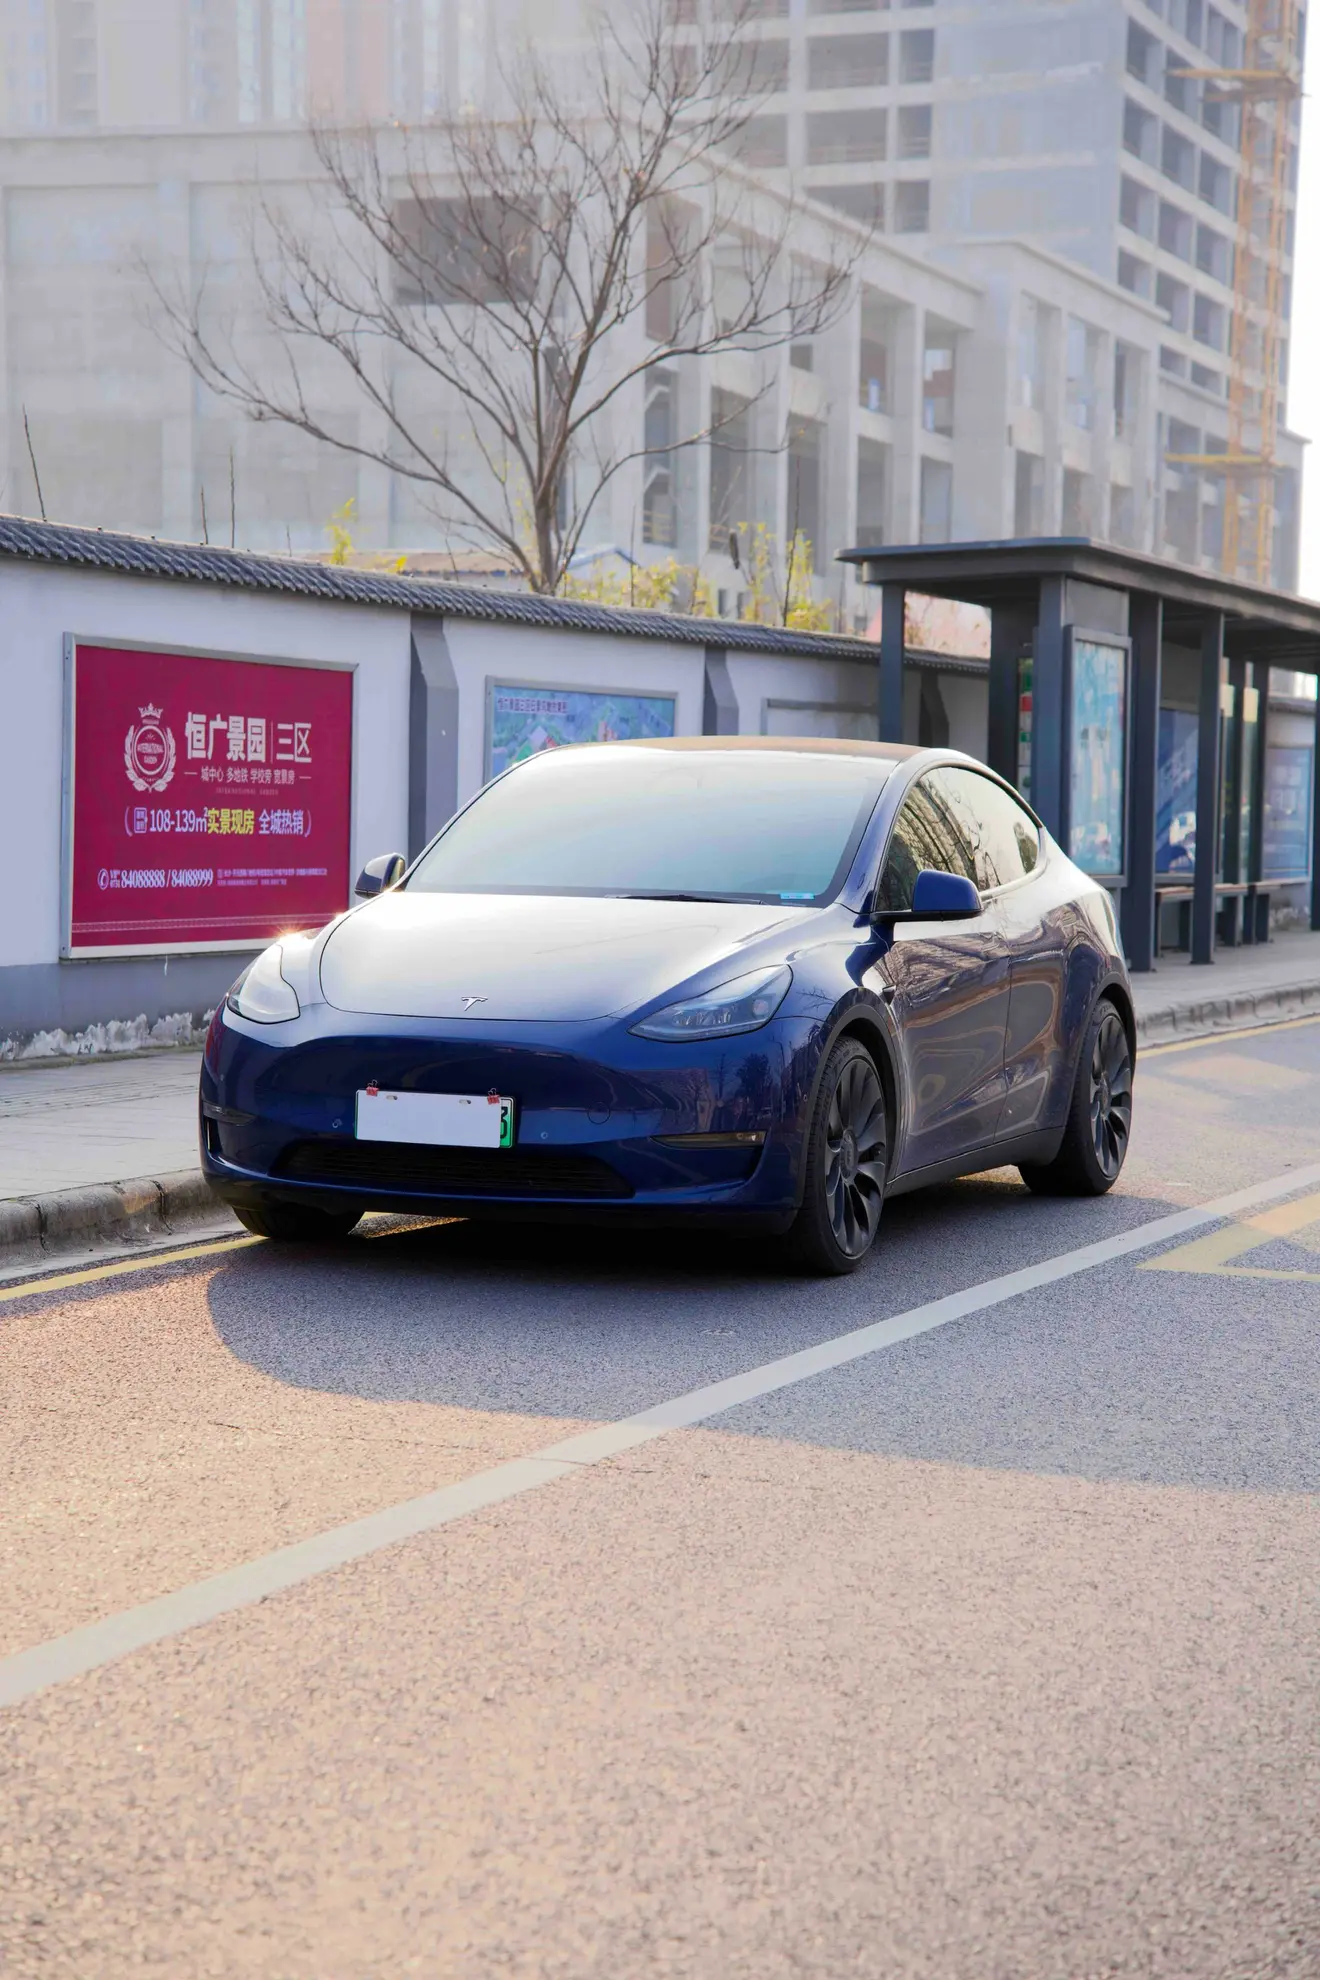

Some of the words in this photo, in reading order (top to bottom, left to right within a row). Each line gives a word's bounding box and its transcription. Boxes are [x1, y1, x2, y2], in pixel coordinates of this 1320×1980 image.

[184, 711, 266, 763] 恒广景园
[276, 722, 312, 763] 三区
[258, 809, 304, 835] 全城热销
